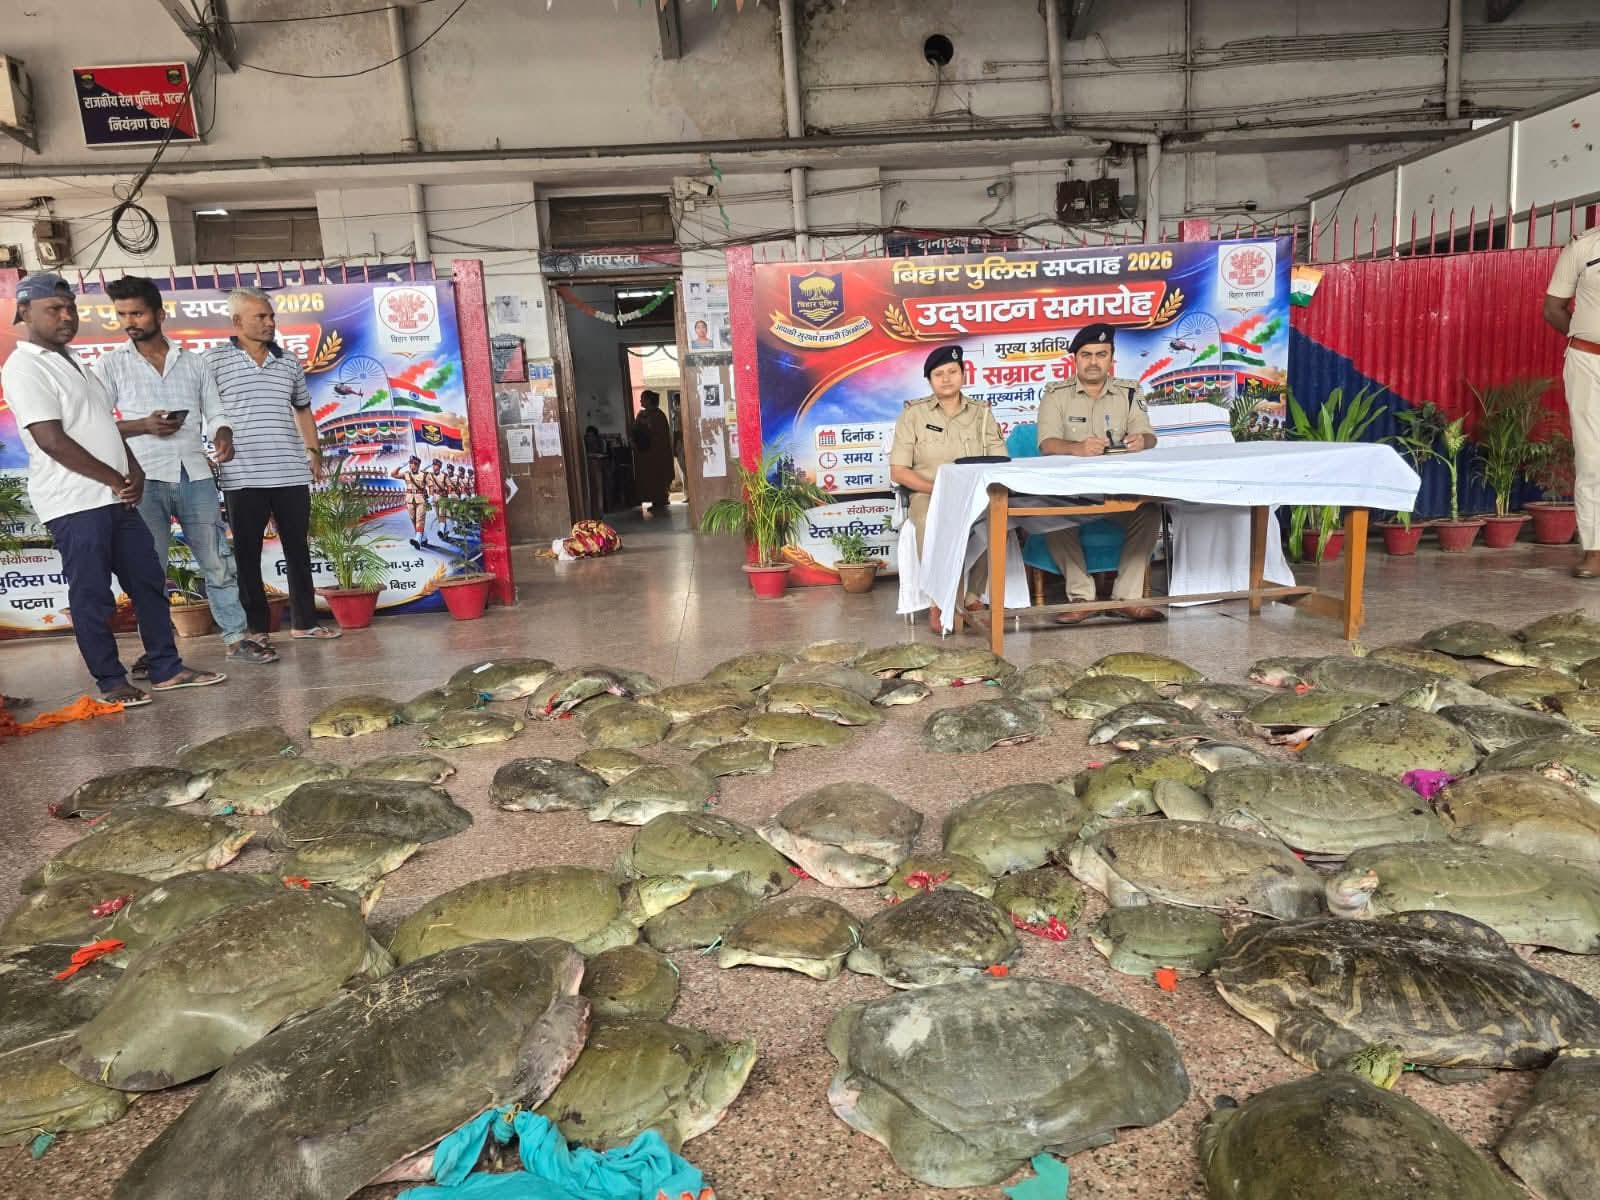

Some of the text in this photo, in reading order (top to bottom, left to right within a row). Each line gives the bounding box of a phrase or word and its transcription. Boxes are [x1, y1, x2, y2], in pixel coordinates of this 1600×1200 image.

[83, 93, 118, 108] राजकीय
[118, 92, 134, 107] रेल
[134, 91, 163, 109] पुलिस,
[108, 117, 170, 131] नियंत्रण कक्ष
[891, 251, 1174, 289] बिहार पुलिस सप्ताह 2026
[275, 293, 325, 313] 2026
[916, 284, 1156, 334] उद्घाटन समारोह
[995, 341, 1028, 360] मुख्य
[983, 363, 1046, 386] सम्राट
[987, 387, 1035, 406] मुख्यमंत्री
[841, 428, 876, 443] दिनांक
[843, 452, 873, 465] समय
[844, 474, 874, 486] स्थान
[808, 524, 834, 538] रेल
[389, 579, 417, 590] बिहार
[10, 597, 55, 611] पटना
